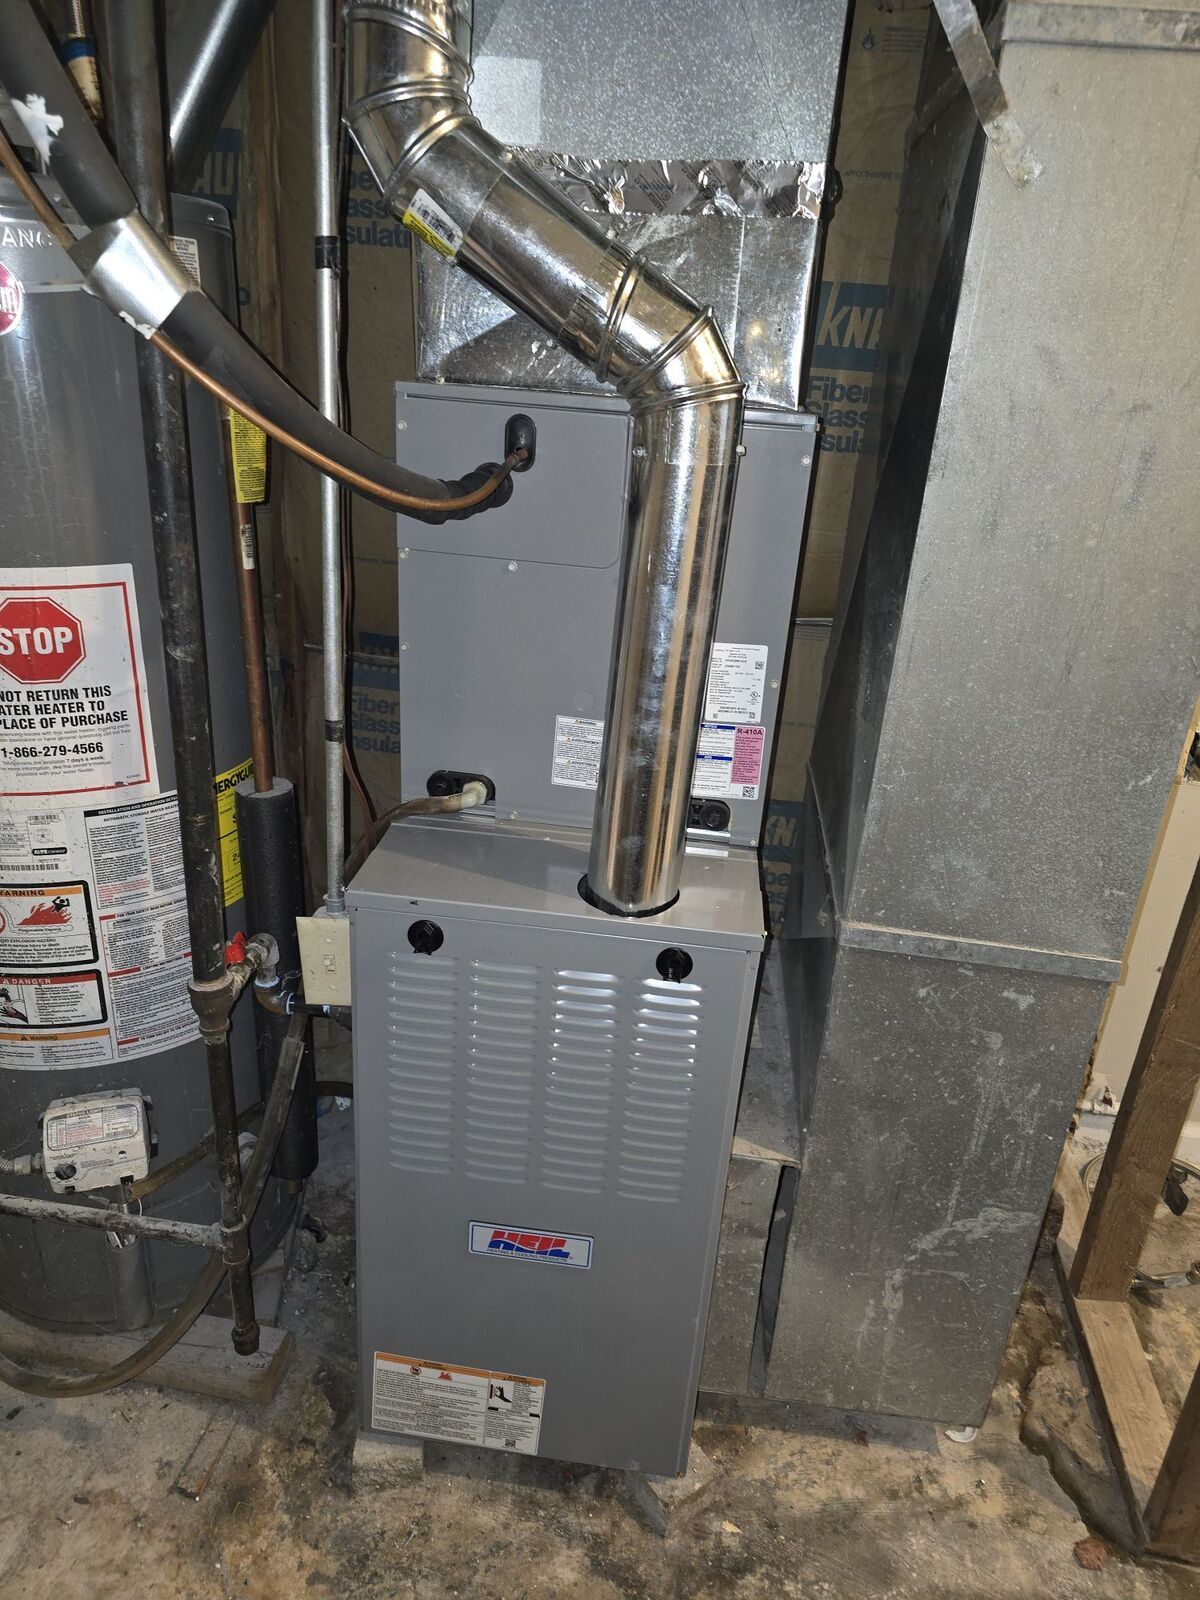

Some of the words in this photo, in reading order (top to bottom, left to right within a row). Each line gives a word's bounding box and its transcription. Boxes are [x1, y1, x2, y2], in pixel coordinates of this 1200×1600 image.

[0, 626, 73, 656] STOP
[26, 688, 79, 702] RETURN
[82, 685, 112, 698] THIS
[34, 702, 86, 715] HEATER
[89, 700, 105, 711] TO
[0, 718, 37, 729] LACE
[40, 717, 57, 729] OF
[61, 710, 129, 728] PURCHASE
[737, 728, 763, 736] R-410A
[1, 741, 104, 758] 1-866-279-4566
[0, 889, 46, 897] ARNING
